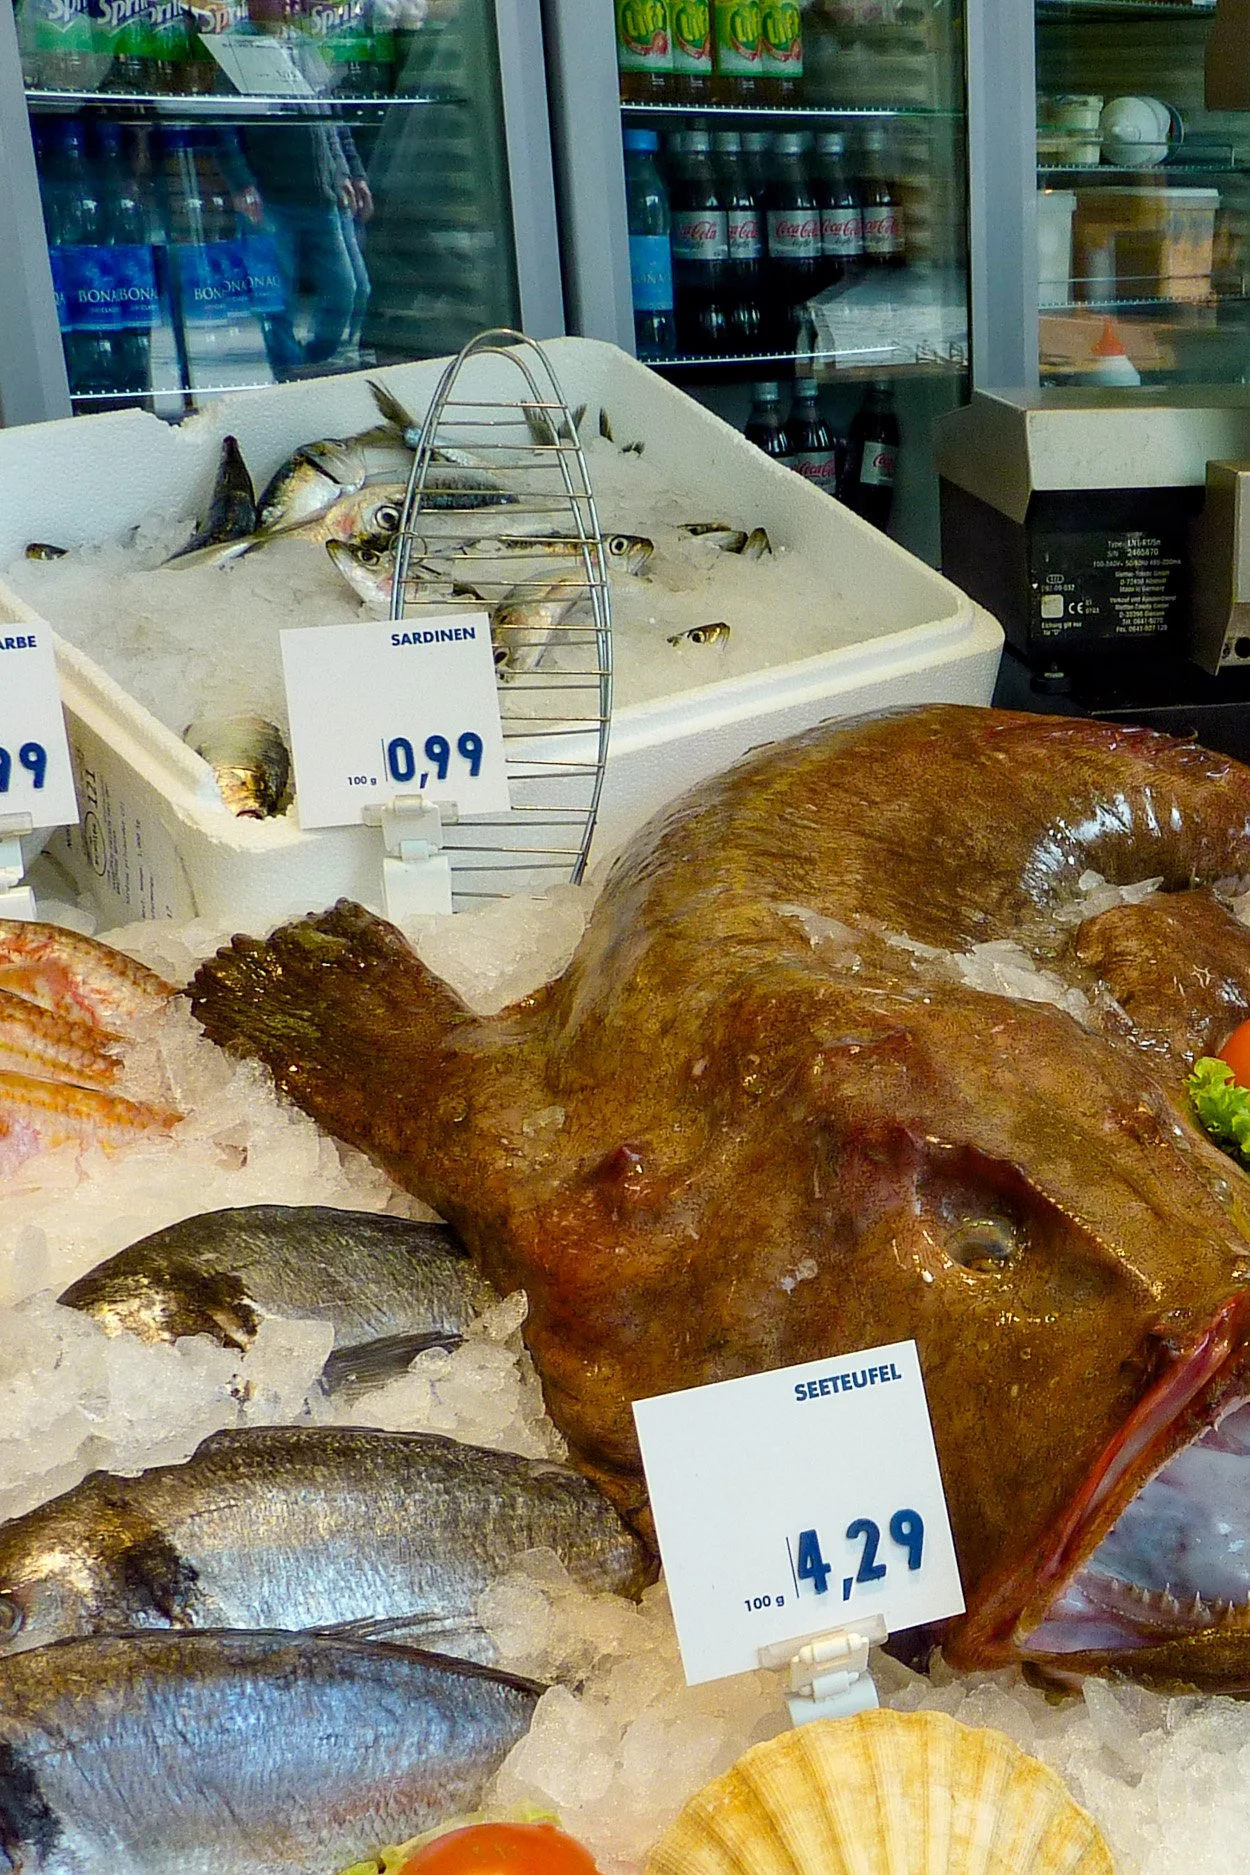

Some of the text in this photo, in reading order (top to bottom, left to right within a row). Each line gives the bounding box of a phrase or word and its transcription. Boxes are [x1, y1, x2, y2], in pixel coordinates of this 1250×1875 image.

[391, 627, 476, 647] SARDINEN
[348, 731, 484, 789] 100 g 0,99
[794, 1363, 902, 1402] SEETEUFEL
[744, 1508, 924, 1613] 100 g 4,29
